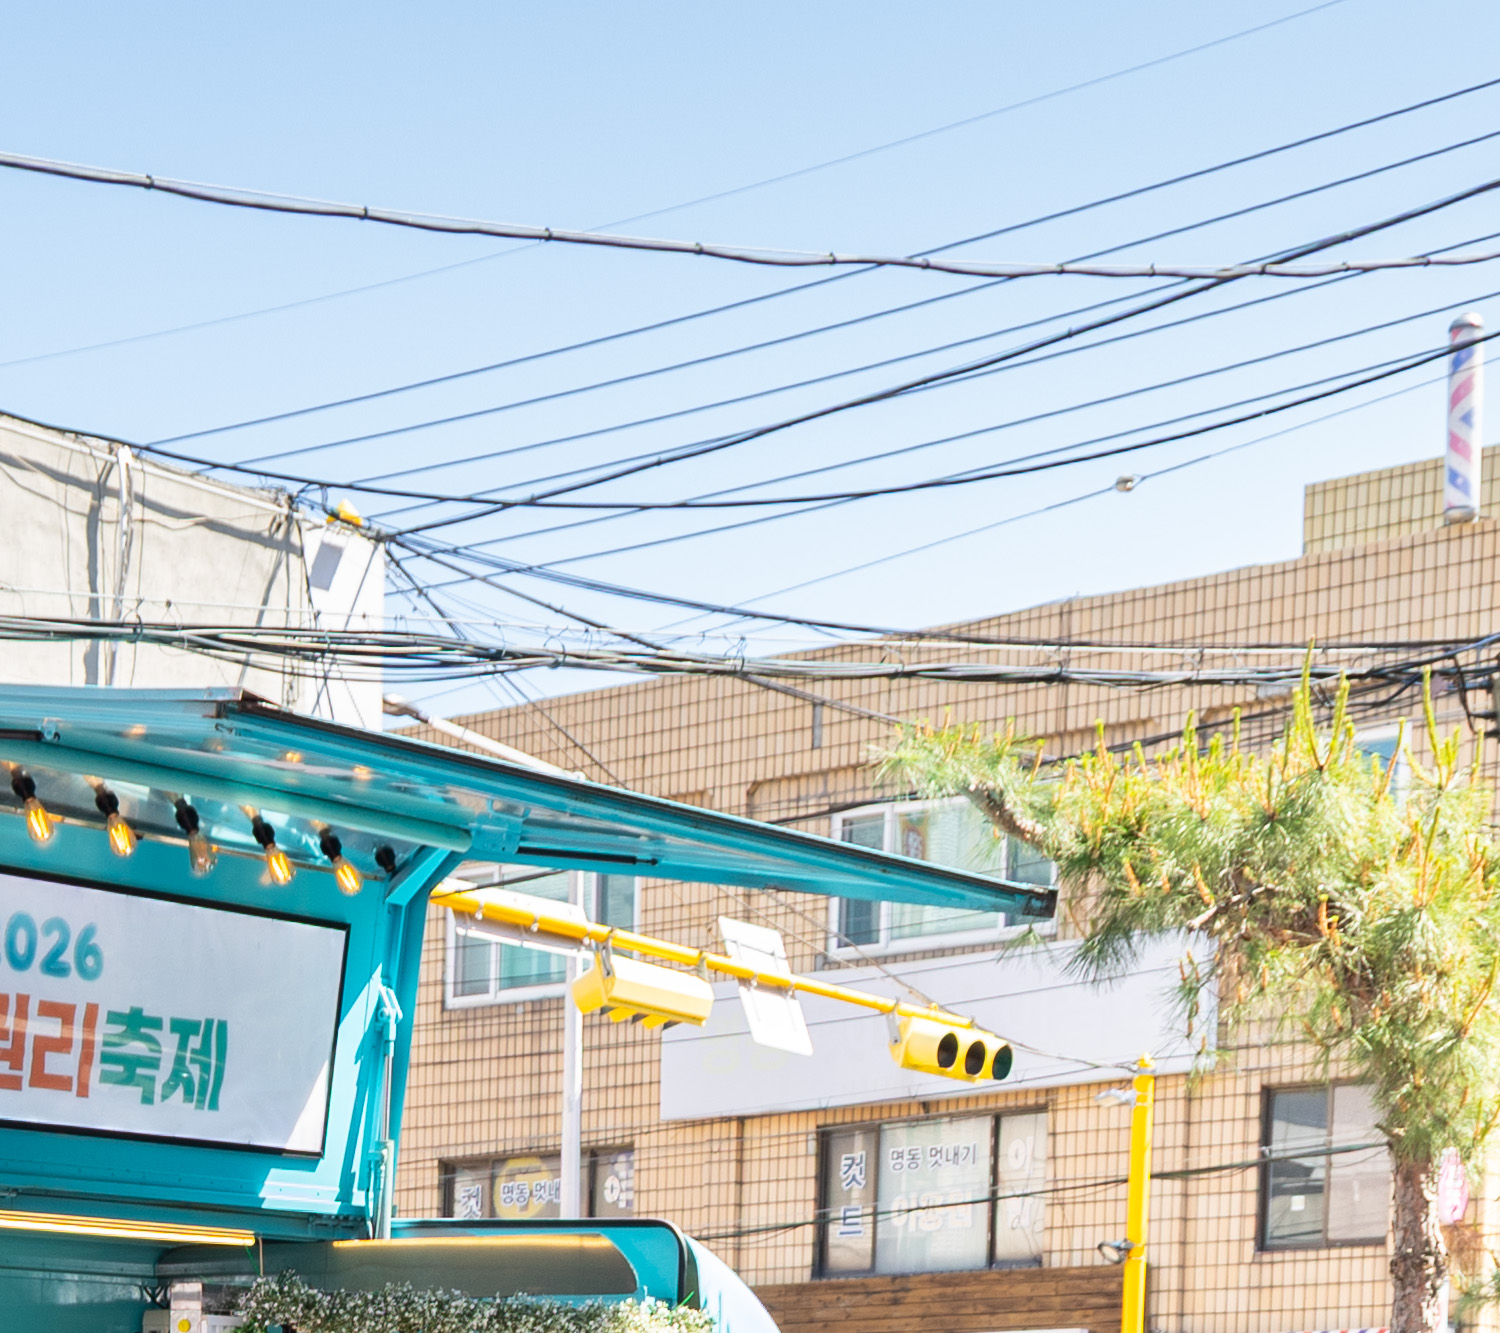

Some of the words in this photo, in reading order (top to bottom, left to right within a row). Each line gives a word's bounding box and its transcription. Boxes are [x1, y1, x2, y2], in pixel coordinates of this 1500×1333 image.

[889, 1147, 921, 1171] 명동
[929, 1143, 978, 1168] 멋내기
[501, 1181, 529, 1206] 명동
